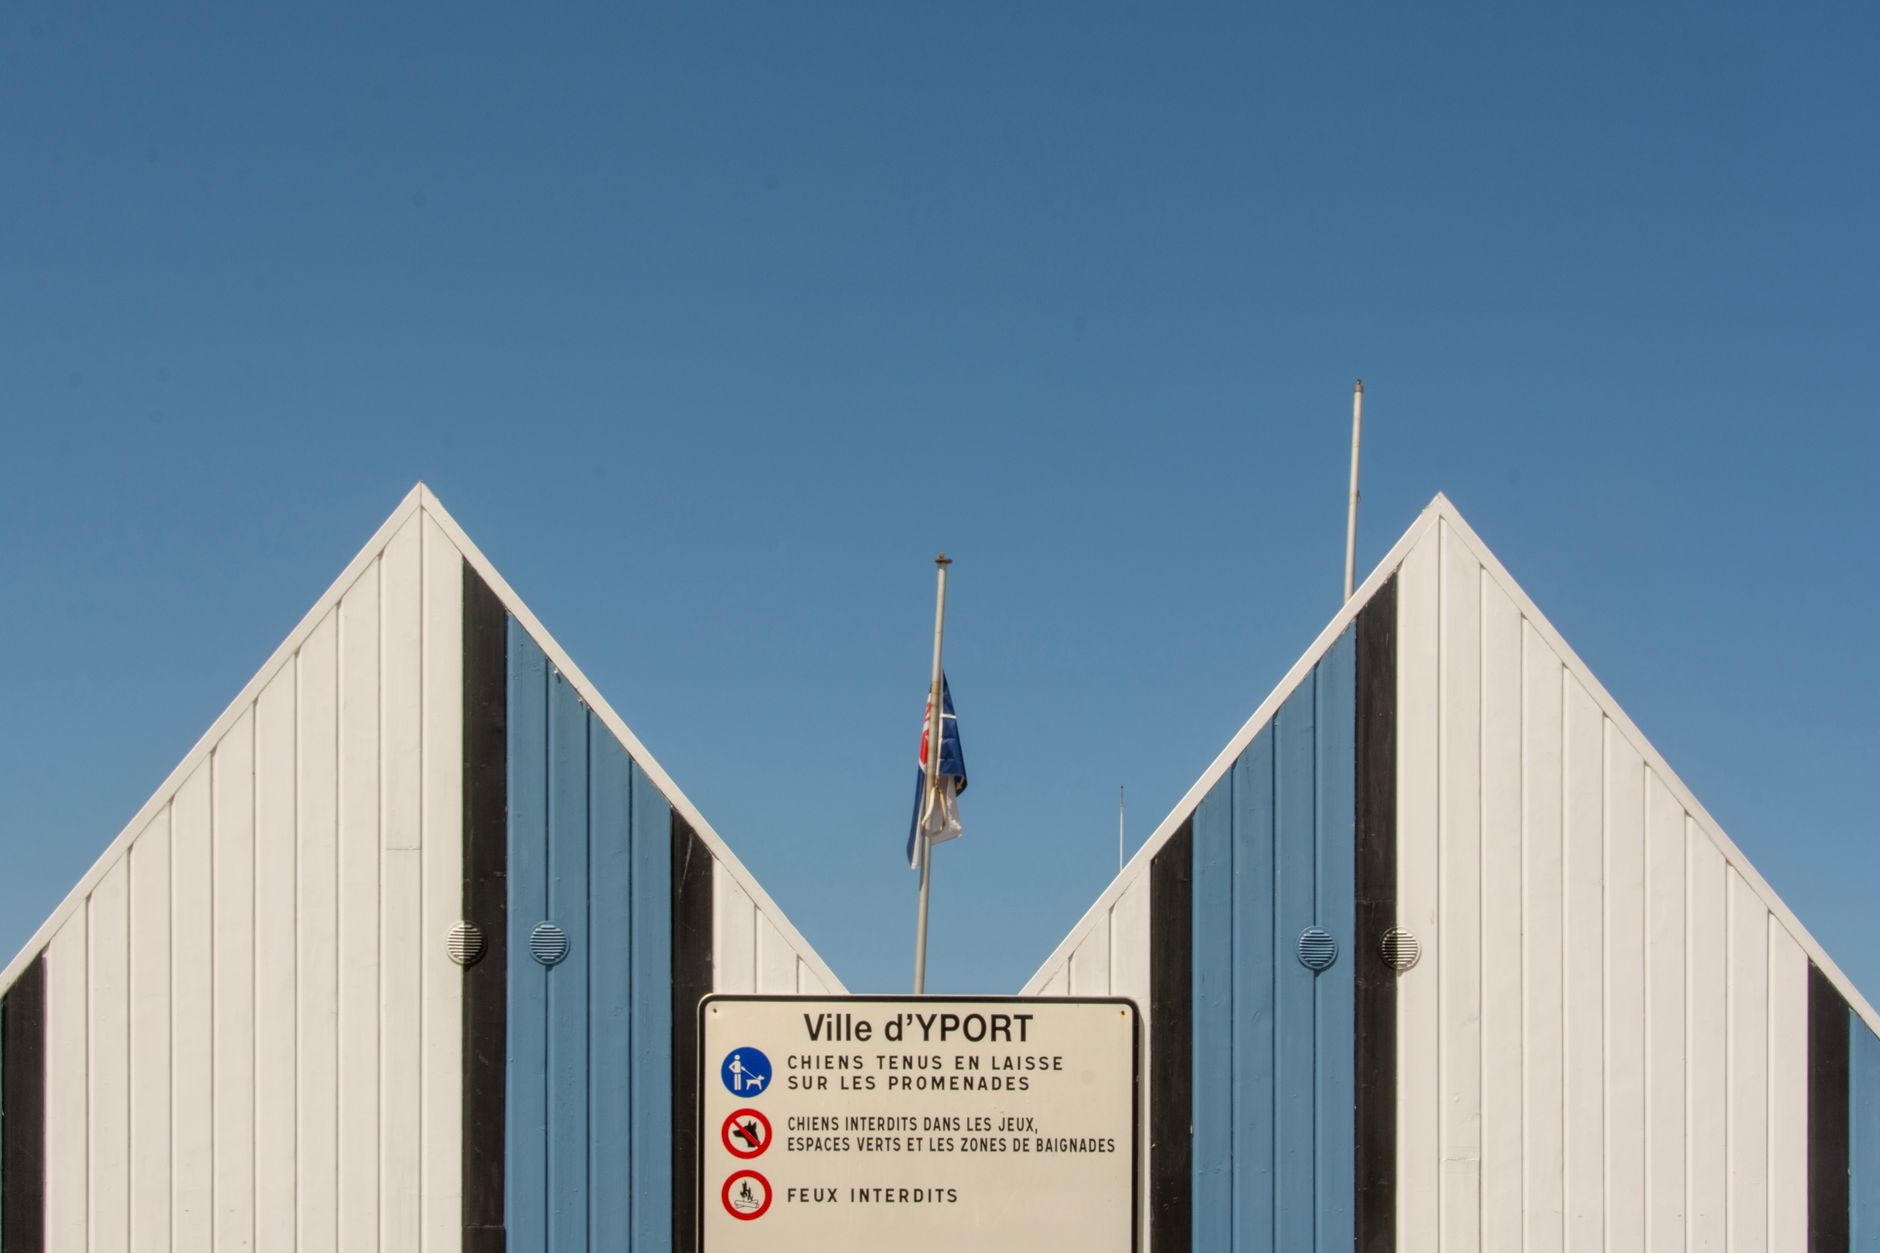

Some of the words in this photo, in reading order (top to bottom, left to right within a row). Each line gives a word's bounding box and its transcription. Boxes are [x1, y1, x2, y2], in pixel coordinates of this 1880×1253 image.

[803, 1011, 873, 1042] Ville
[884, 1011, 1034, 1043] d'YPORT
[787, 1054, 864, 1070] CHIENS
[876, 1054, 943, 1071] TENUS
[954, 1055, 979, 1071] EN
[991, 1055, 1064, 1071] LAISSE
[787, 1075, 828, 1091] SUR
[840, 1075, 876, 1091] LES
[888, 1075, 1030, 1091] PROMENADES
[787, 1116, 840, 1132] CHIENS
[844, 1116, 918, 1132] INTERDITS
[923, 1116, 961, 1132] DANS
[966, 1116, 992, 1132] LES
[997, 1117, 1039, 1135] JEUX,
[787, 1136, 850, 1152] ESPACES
[857, 1137, 901, 1152] VERTS
[907, 1137, 924, 1152] ET
[929, 1137, 955, 1152] LES
[960, 1137, 1007, 1153] ZONES
[1012, 1137, 1031, 1153] DE
[1036, 1137, 1116, 1153] BAIGNADES
[787, 1188, 838, 1204] FEUX
[850, 1188, 958, 1204] INTERDITS
